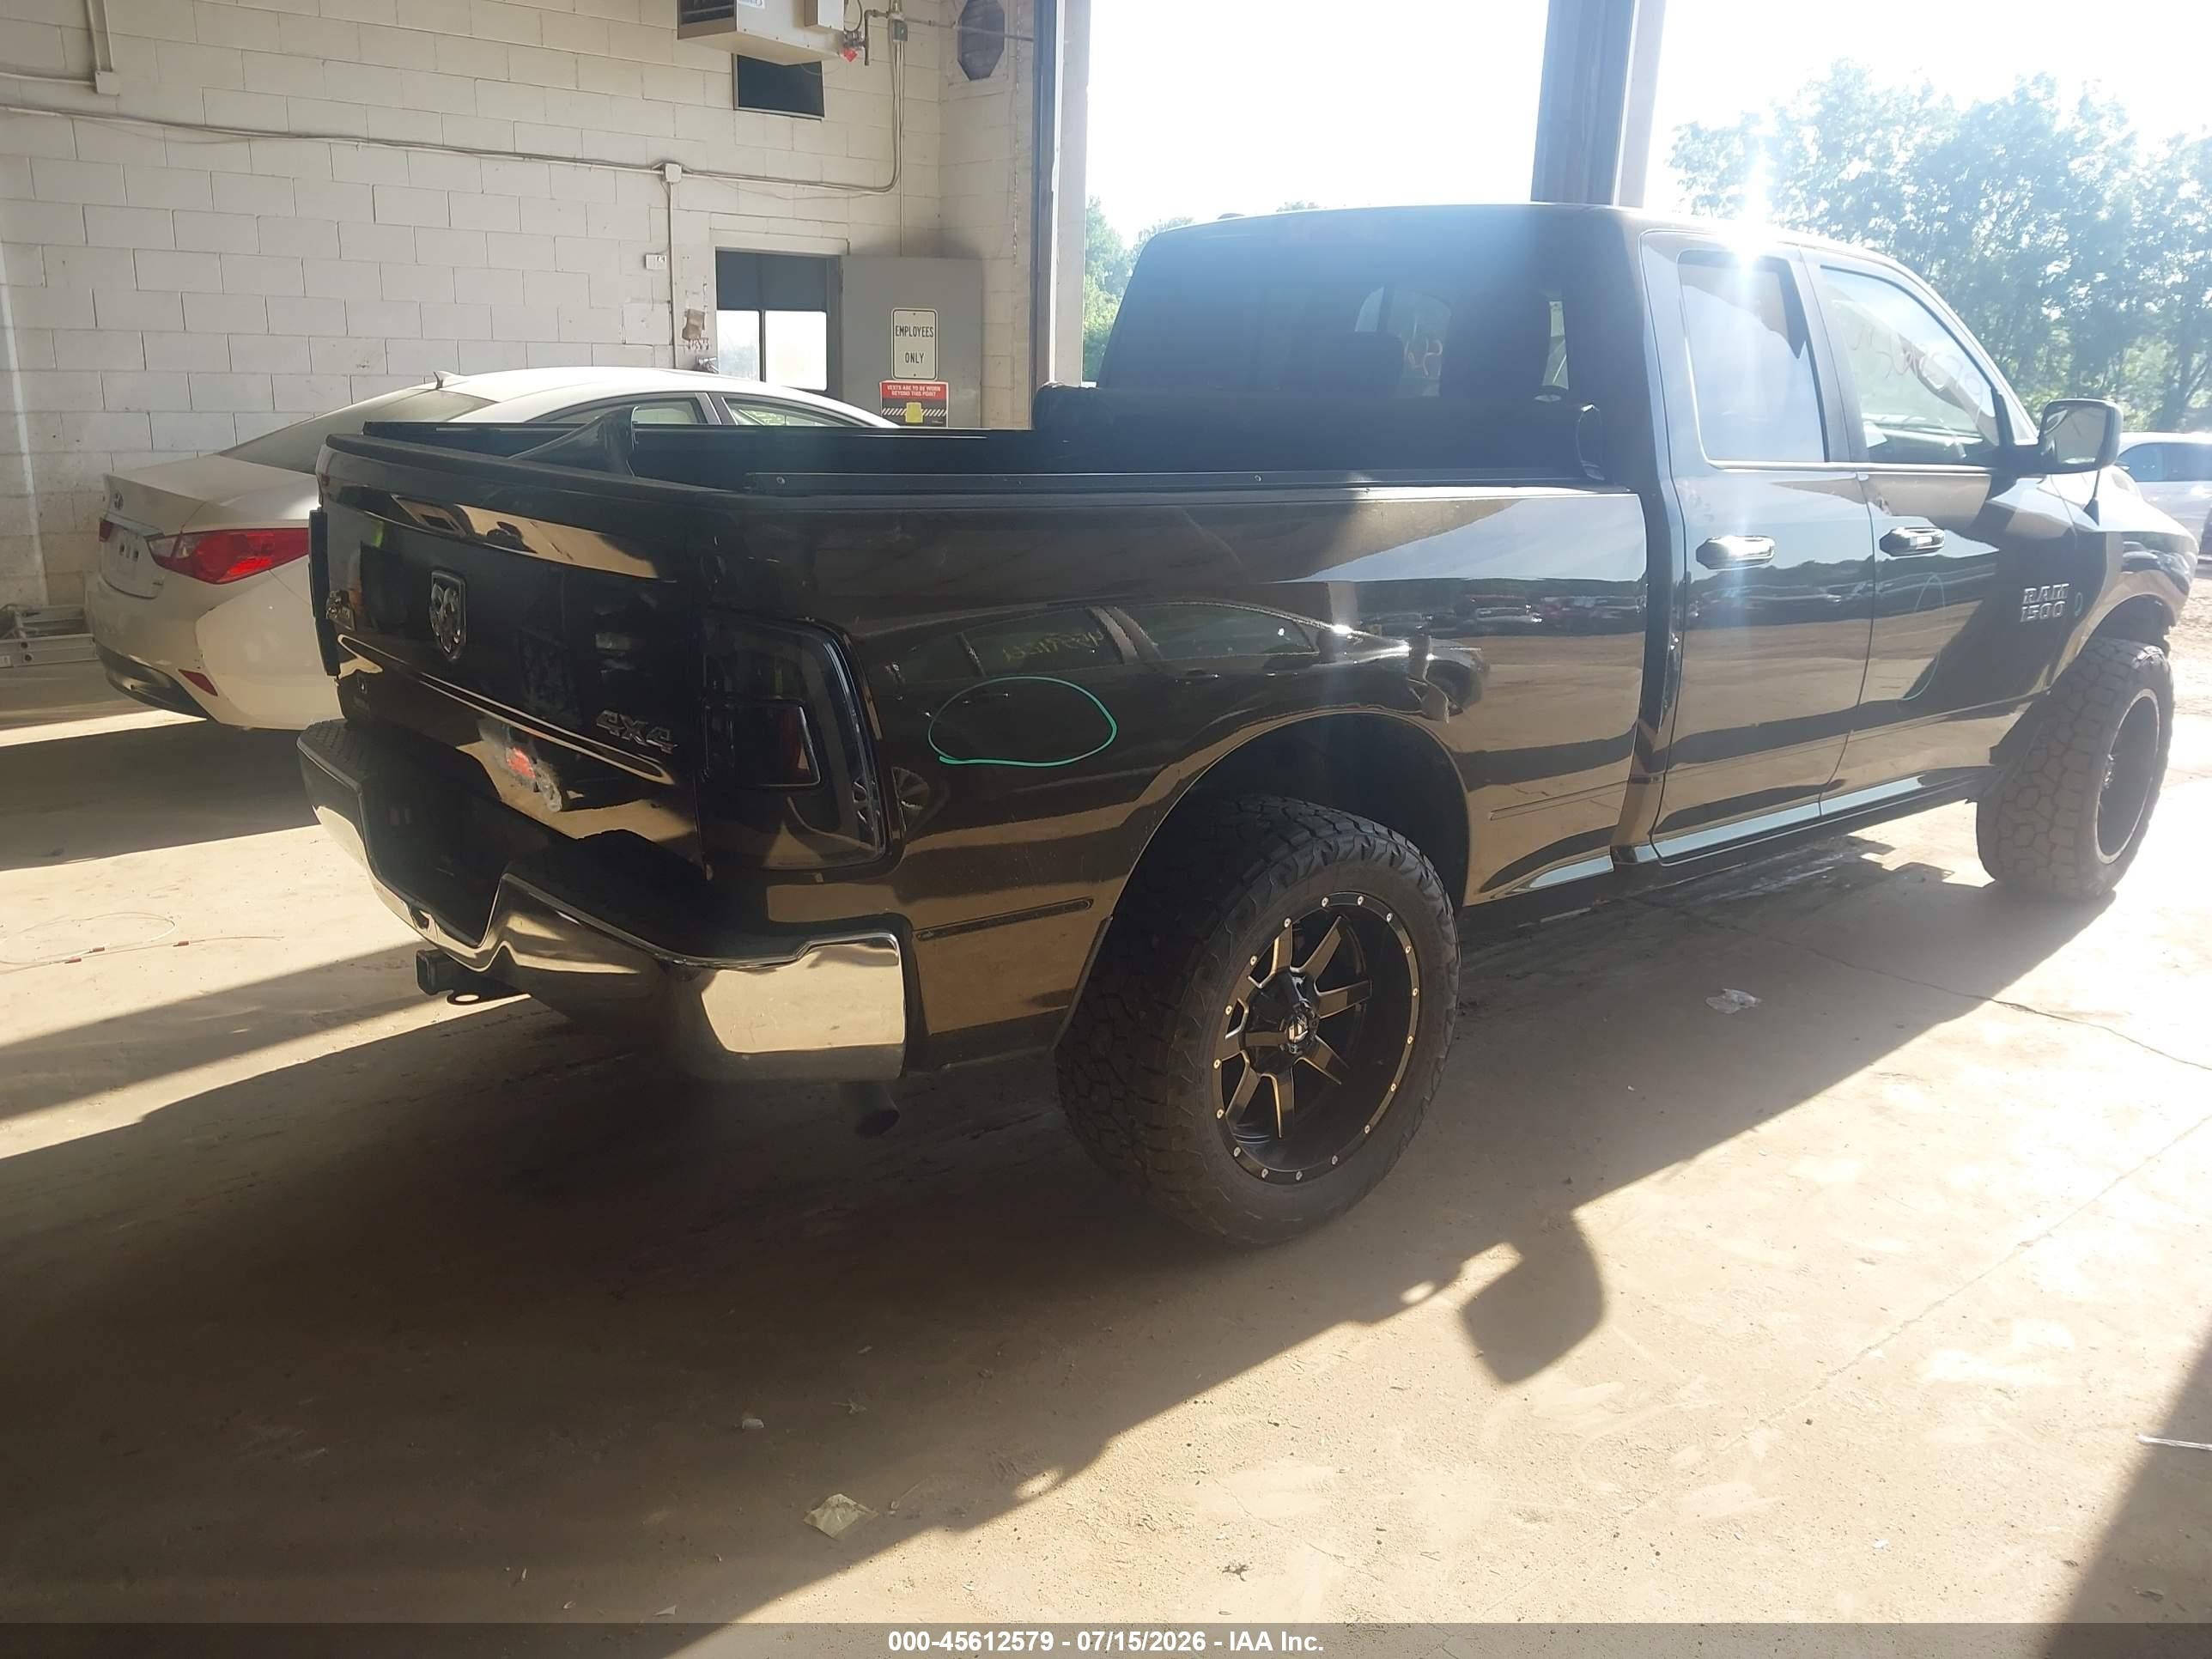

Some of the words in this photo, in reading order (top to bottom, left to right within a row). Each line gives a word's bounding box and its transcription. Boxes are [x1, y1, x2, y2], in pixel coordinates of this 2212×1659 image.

[895, 325, 934, 337] EMPLOYEES
[904, 352, 925, 364] ONLY
[2023, 583, 2069, 604] RAM
[2020, 600, 2066, 623] 1500
